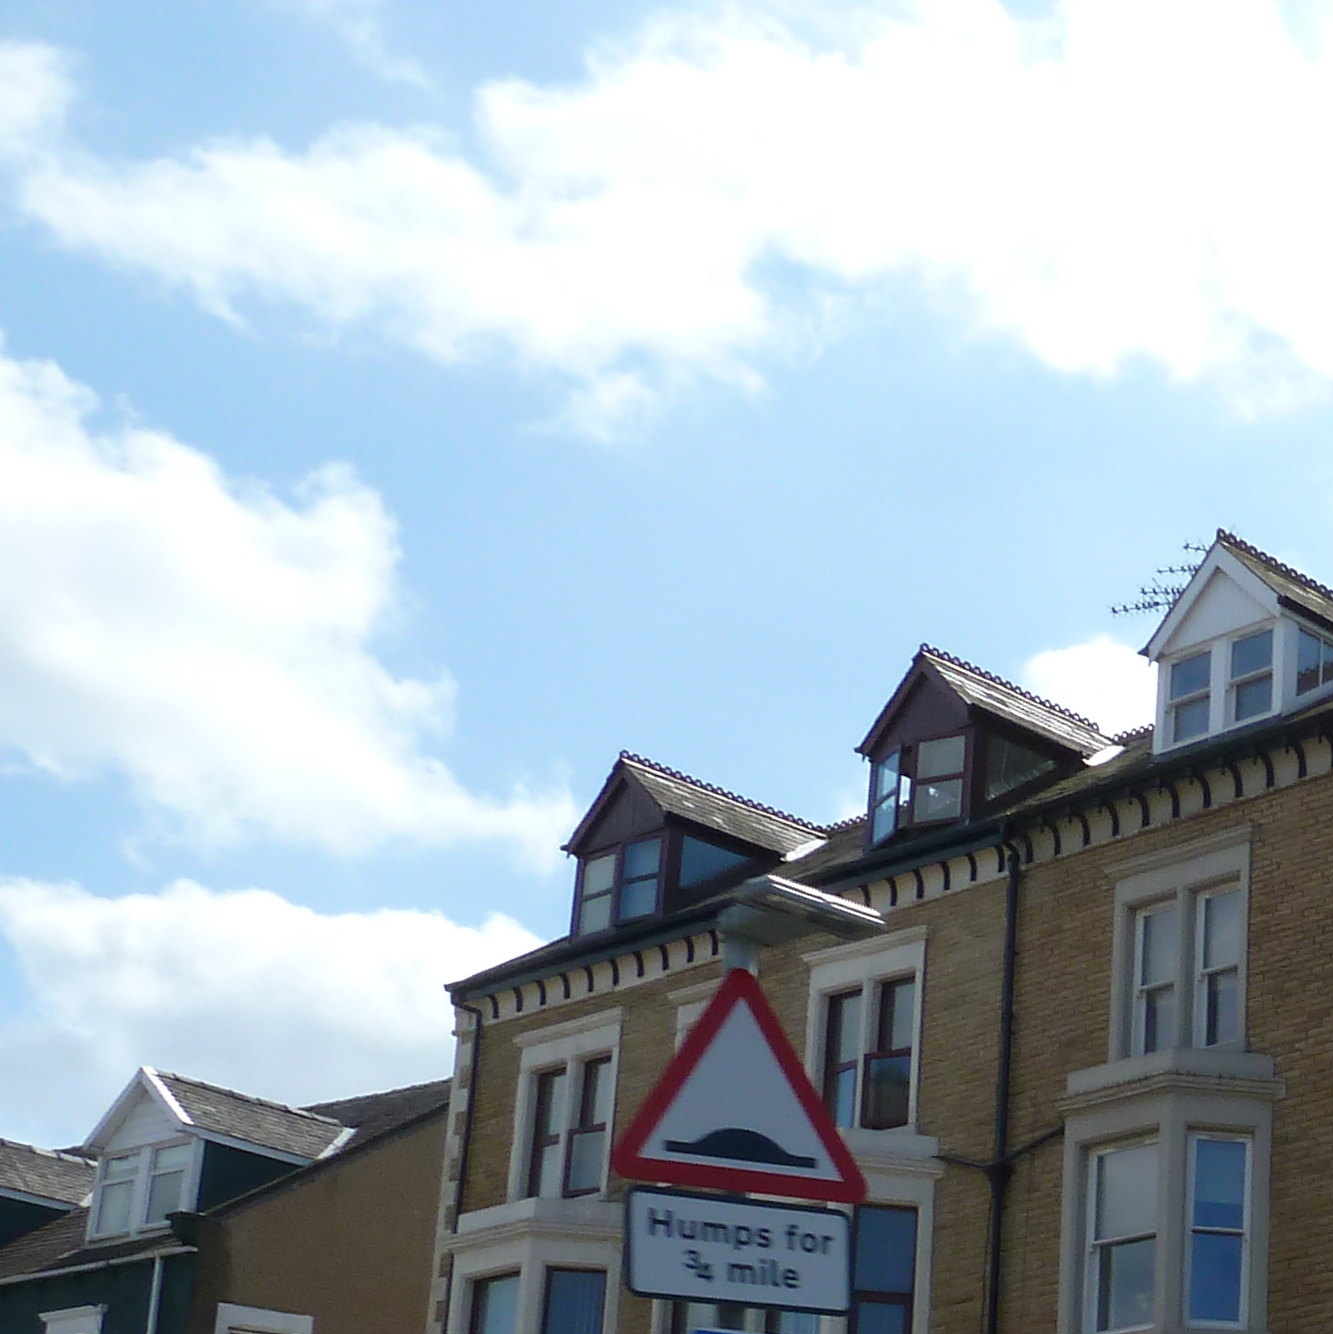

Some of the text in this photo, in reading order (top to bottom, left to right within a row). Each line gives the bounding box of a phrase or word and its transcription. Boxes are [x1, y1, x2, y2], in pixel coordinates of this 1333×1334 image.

[648, 1207, 833, 1254] Humps for
[727, 1259, 800, 1289] mile
